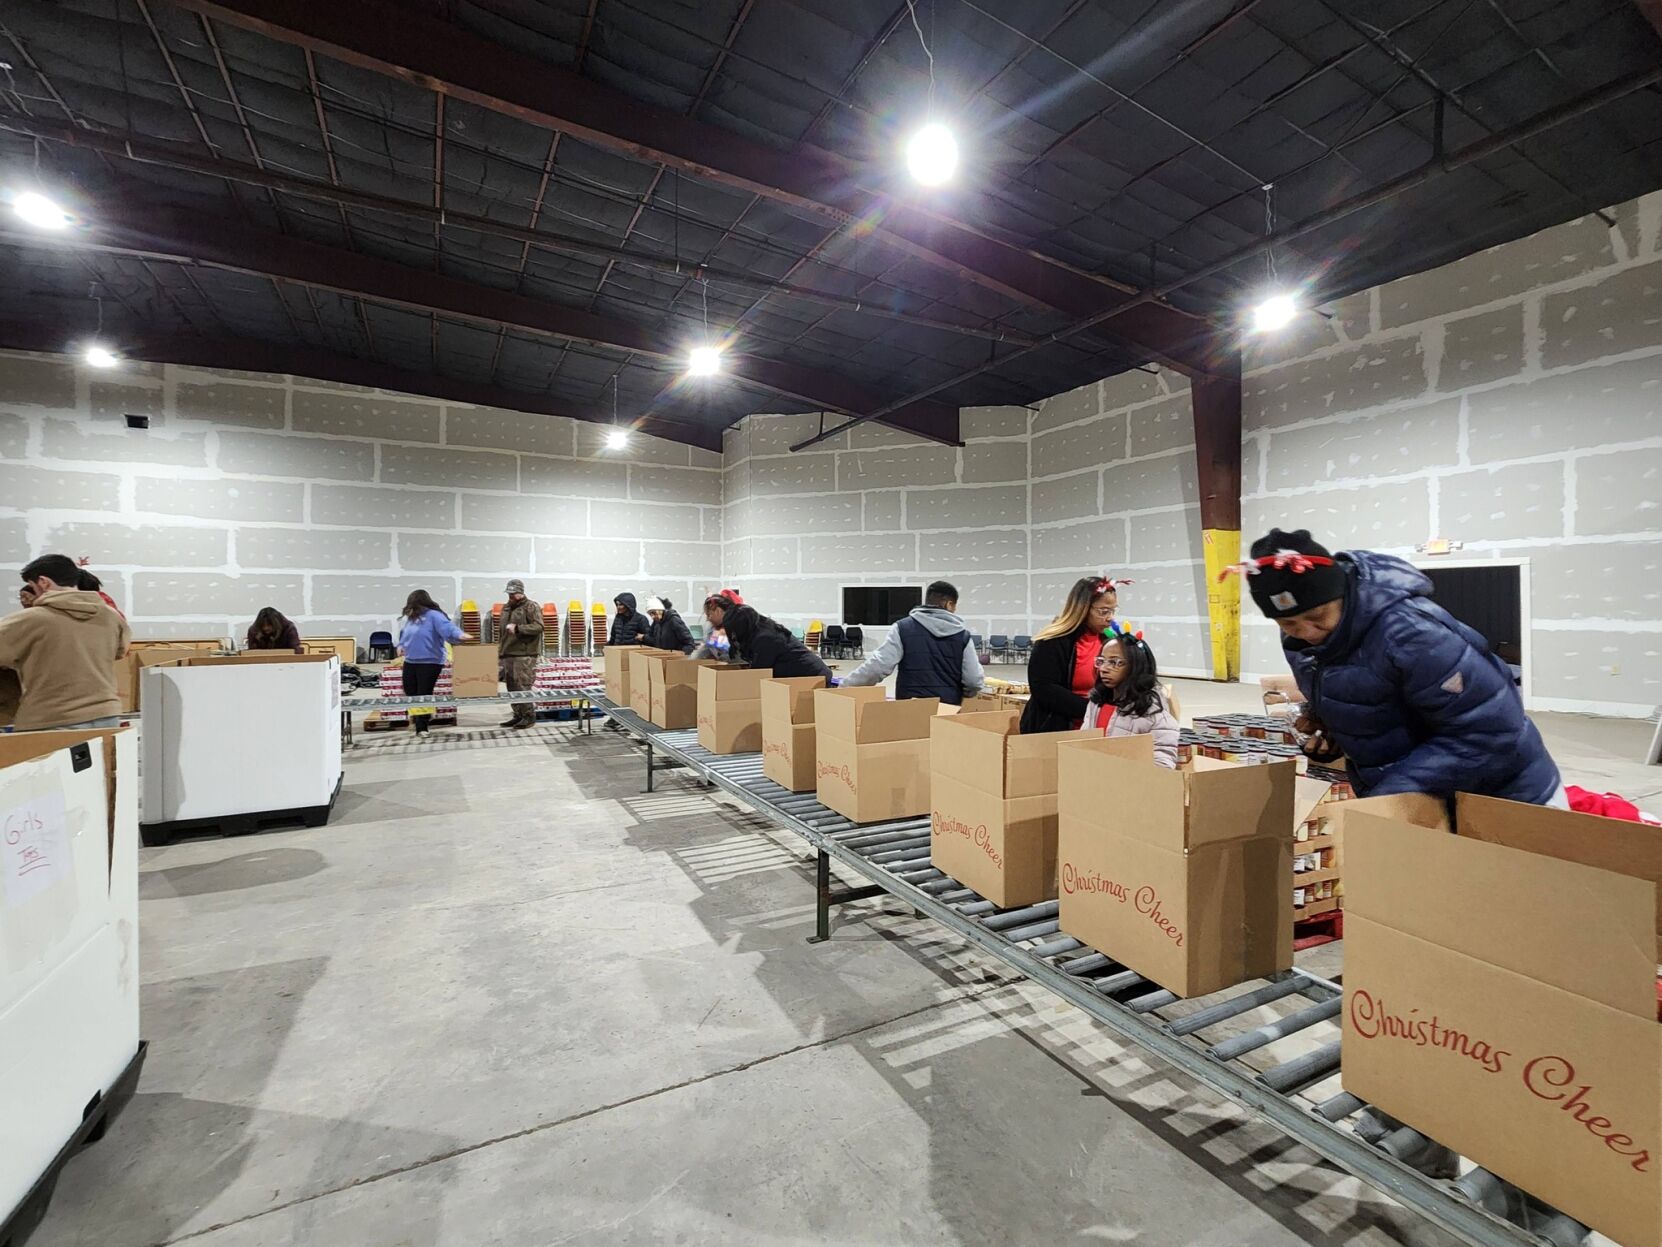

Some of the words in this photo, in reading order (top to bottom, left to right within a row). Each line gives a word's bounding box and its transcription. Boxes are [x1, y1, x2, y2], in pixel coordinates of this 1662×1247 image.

[933, 811, 973, 839] Christmas
[975, 825, 1003, 869] Cheer
[1062, 863, 1130, 903] Christmas
[1135, 886, 1183, 947] Cheer
[1351, 990, 1512, 1073] Christmas
[1523, 1056, 1650, 1172] Cheer
